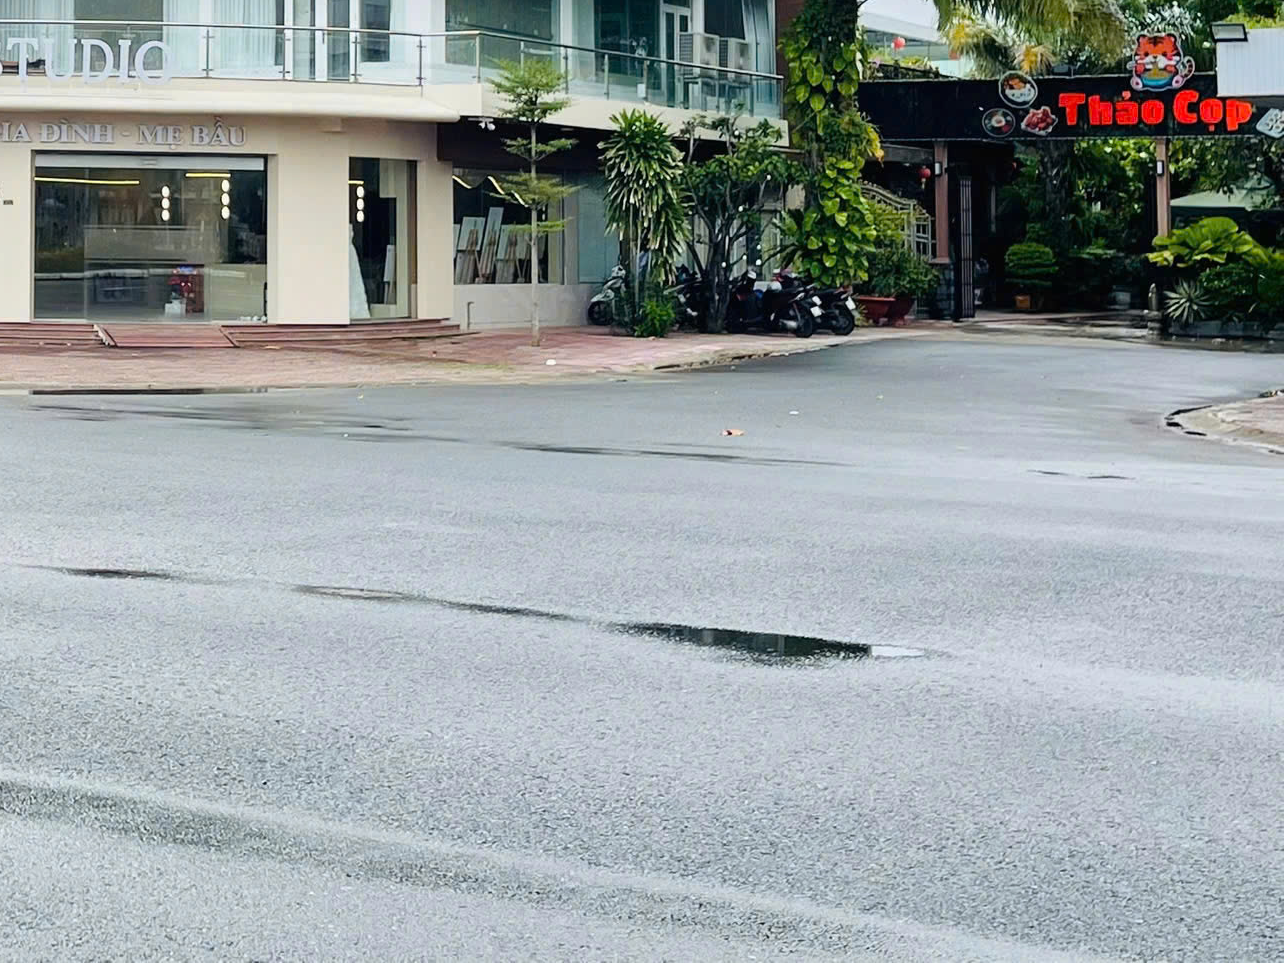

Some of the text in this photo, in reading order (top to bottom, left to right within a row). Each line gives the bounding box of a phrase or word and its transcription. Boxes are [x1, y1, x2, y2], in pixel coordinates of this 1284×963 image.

[1058, 89, 1253, 132] Thảo Cọp
[40, 118, 115, 144] ĐÌNH
[138, 124, 183, 150] MẸ
[191, 116, 247, 147] BẦU
